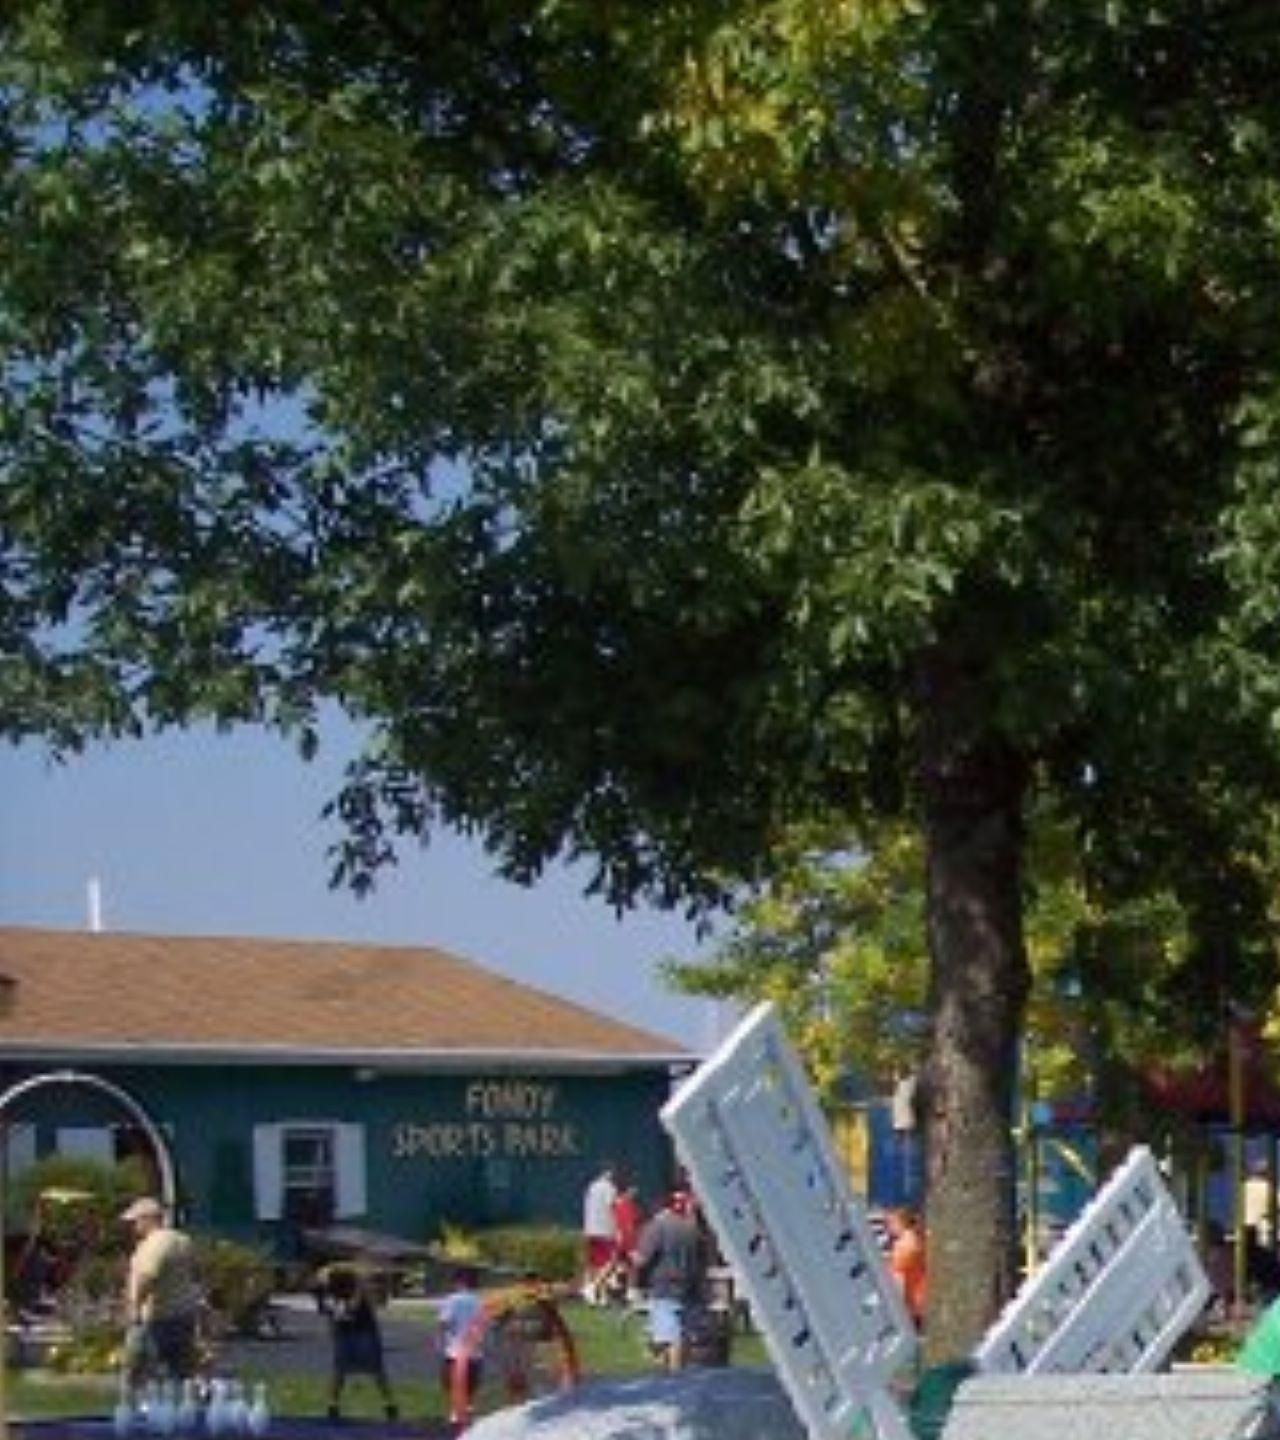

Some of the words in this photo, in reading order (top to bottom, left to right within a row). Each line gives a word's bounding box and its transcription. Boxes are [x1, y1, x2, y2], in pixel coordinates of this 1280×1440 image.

[465, 1081, 557, 1118] FONDY
[391, 1122, 496, 1158] SPORTS
[504, 1122, 582, 1156] PARK
